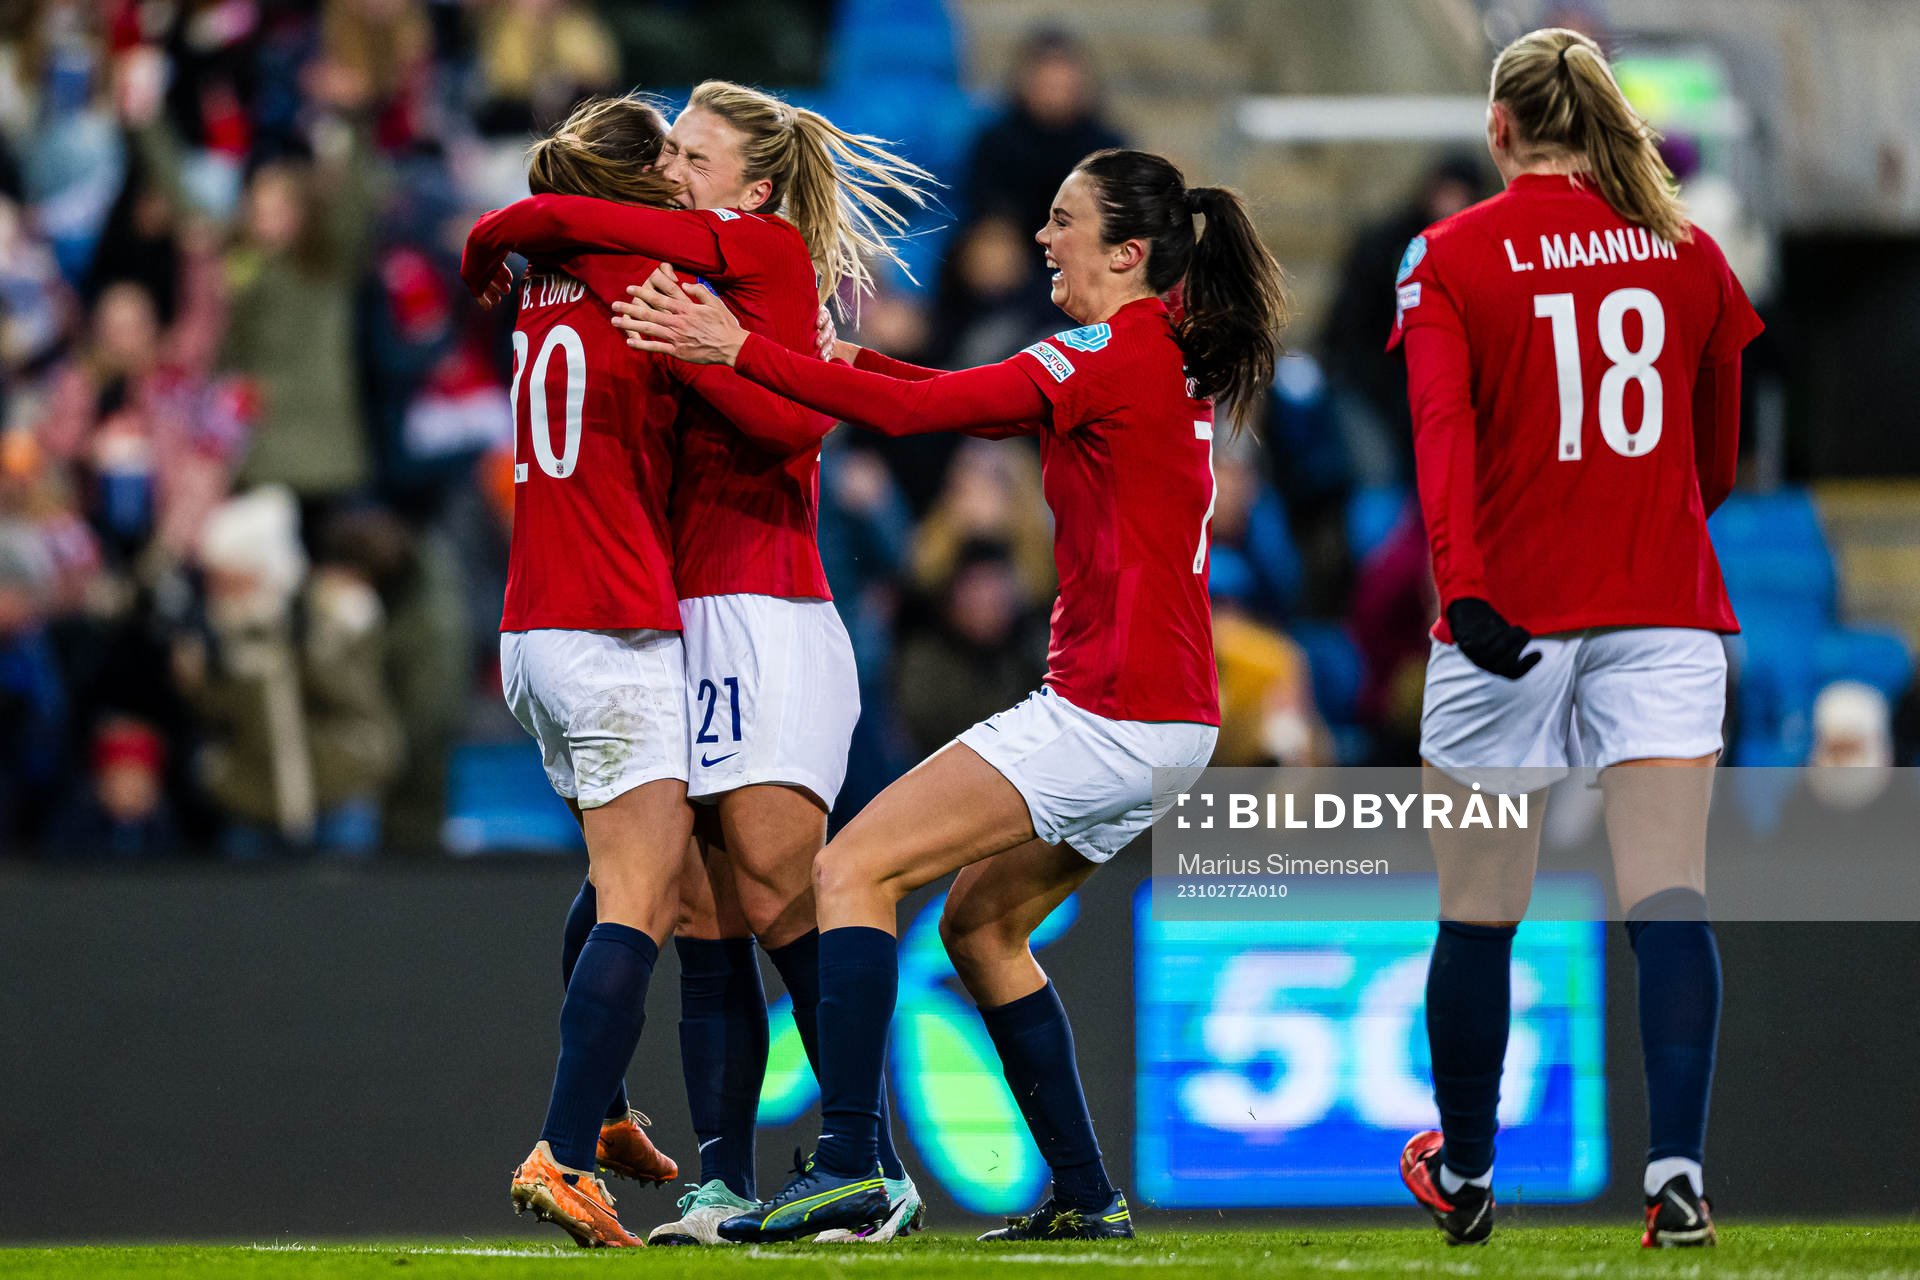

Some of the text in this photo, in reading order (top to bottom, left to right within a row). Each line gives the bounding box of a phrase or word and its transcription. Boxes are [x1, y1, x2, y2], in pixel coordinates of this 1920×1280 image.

[1503, 226, 1677, 272] L. MAANUM
[522, 276, 586, 311] B. LUND
[1533, 287, 1666, 461] 18
[696, 677, 742, 744] 21
